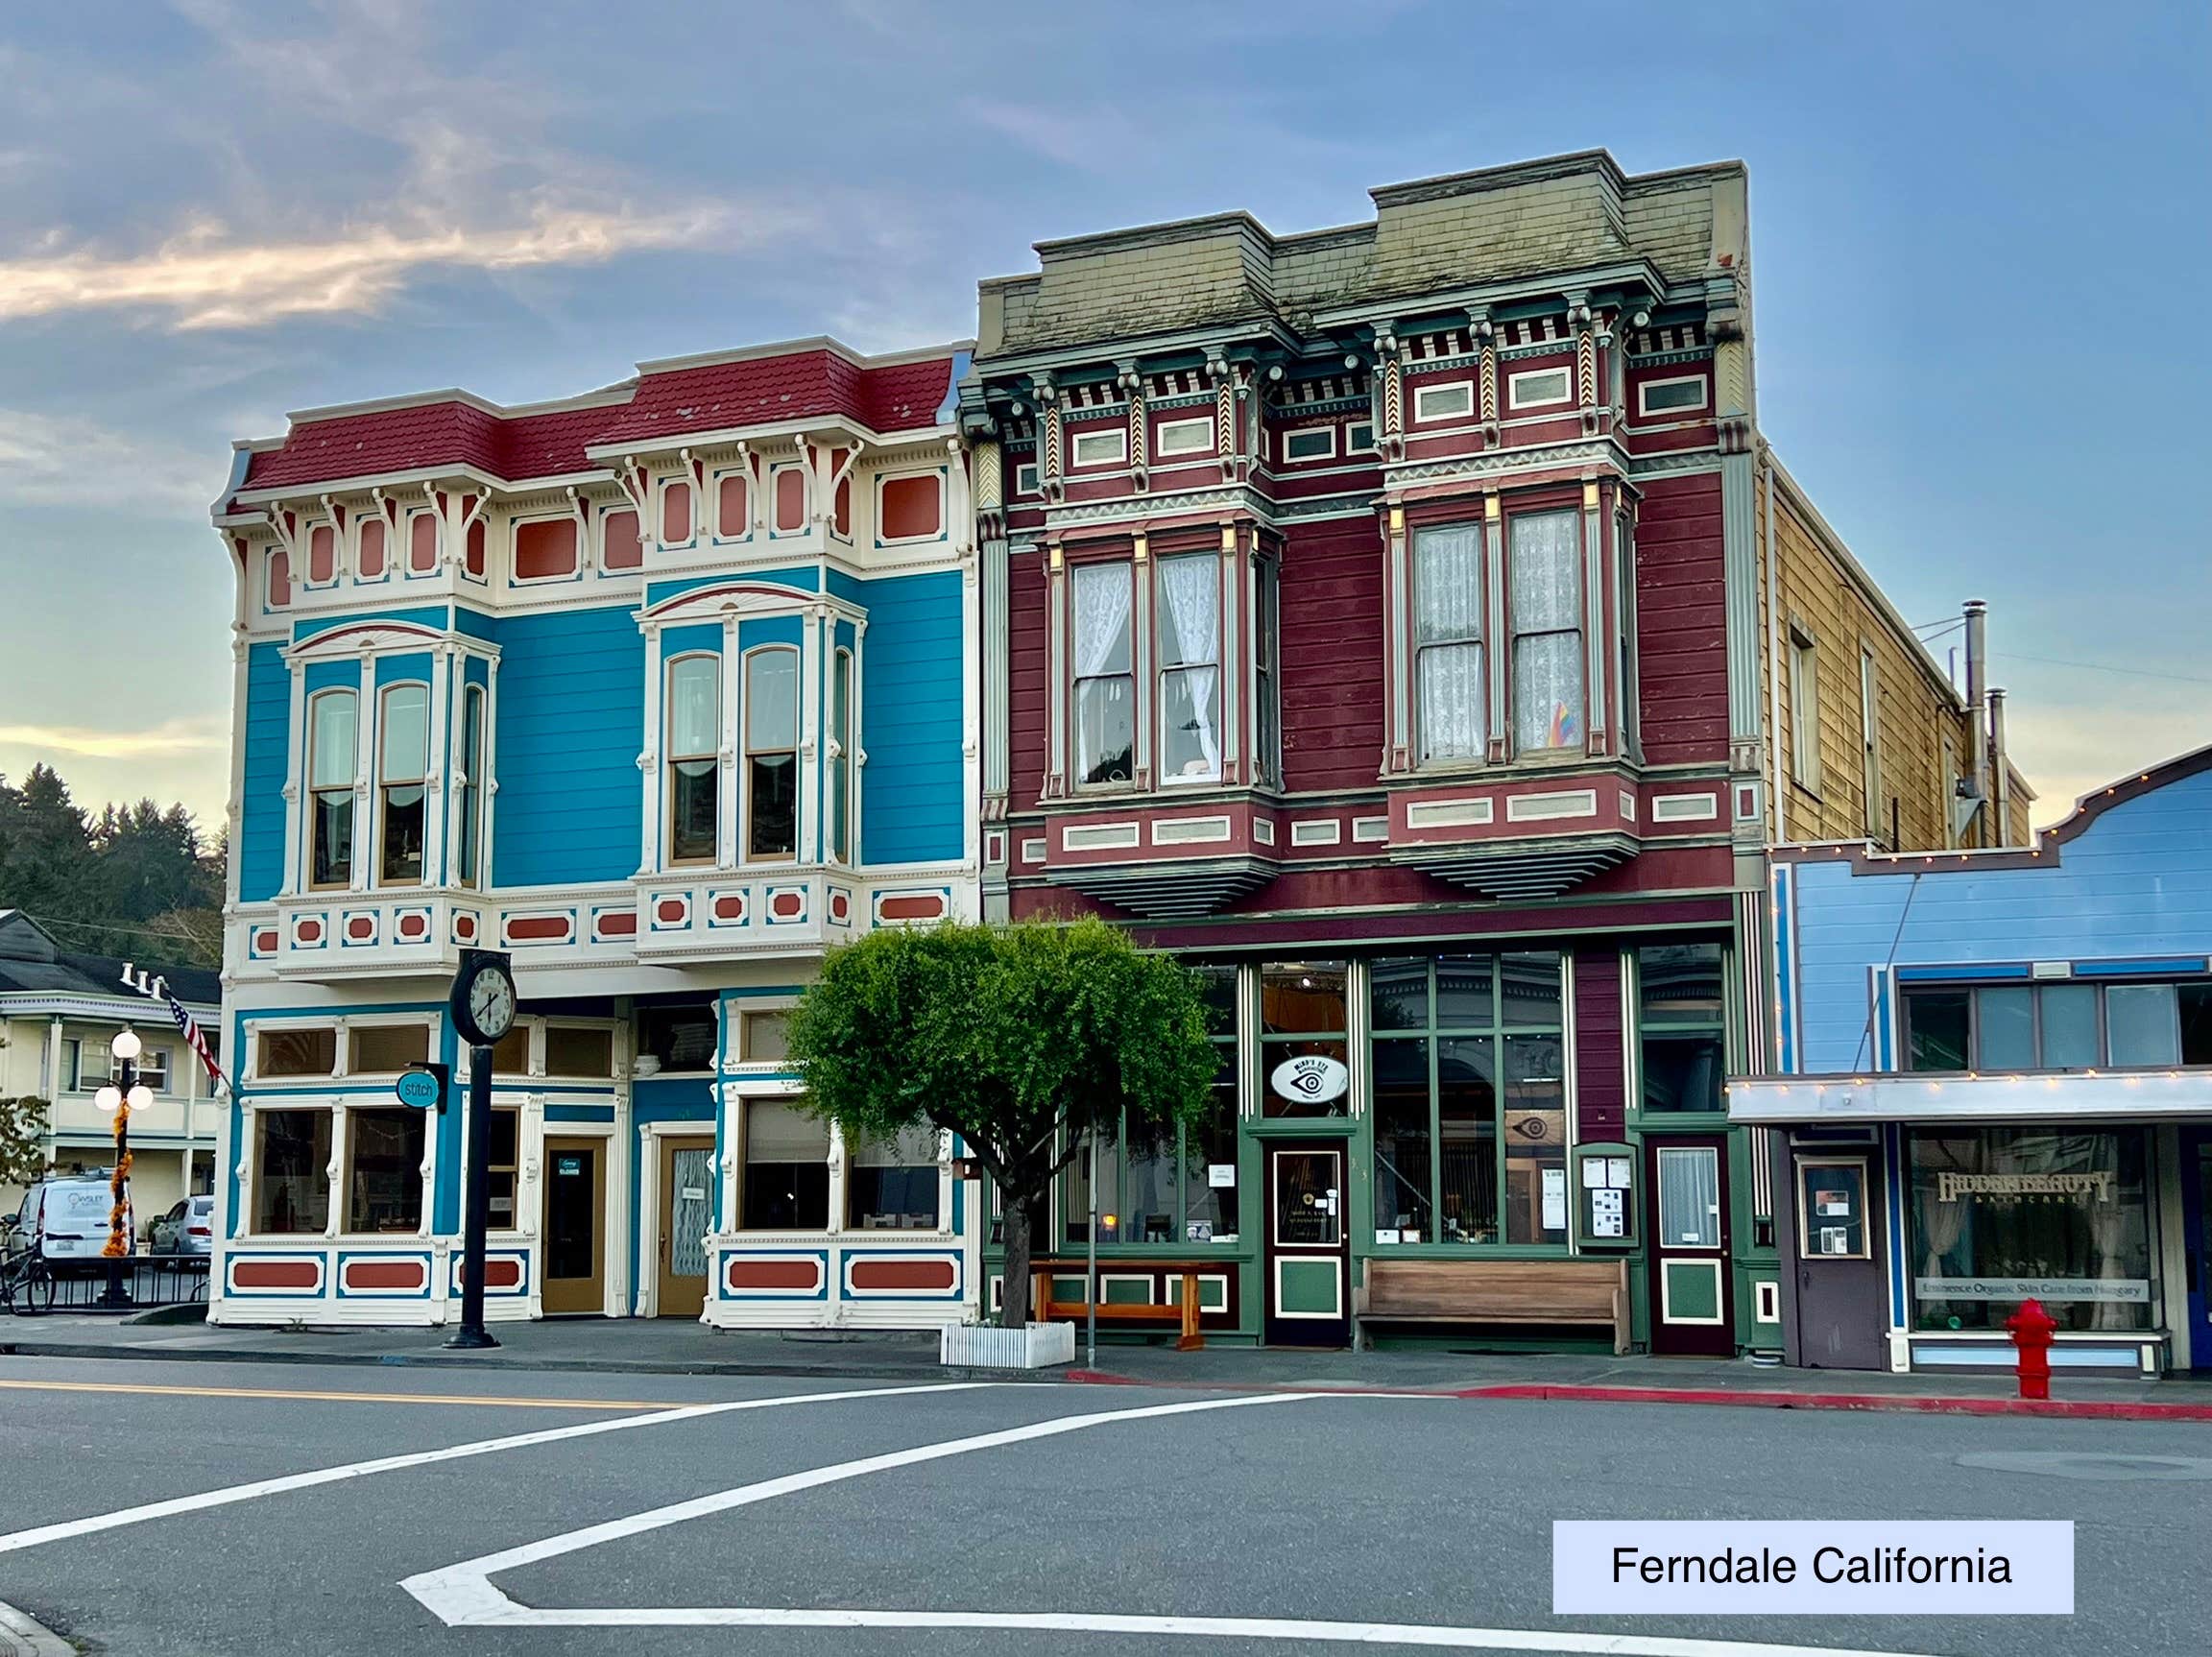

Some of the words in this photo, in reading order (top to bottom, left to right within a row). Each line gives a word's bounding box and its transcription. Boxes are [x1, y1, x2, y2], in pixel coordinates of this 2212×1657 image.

[405, 1082, 433, 1097] stitch
[1973, 1283, 2014, 1296] Organic
[2016, 1283, 2040, 1293] Skin
[2041, 1283, 2065, 1294] Care
[2066, 1284, 2093, 1295] from
